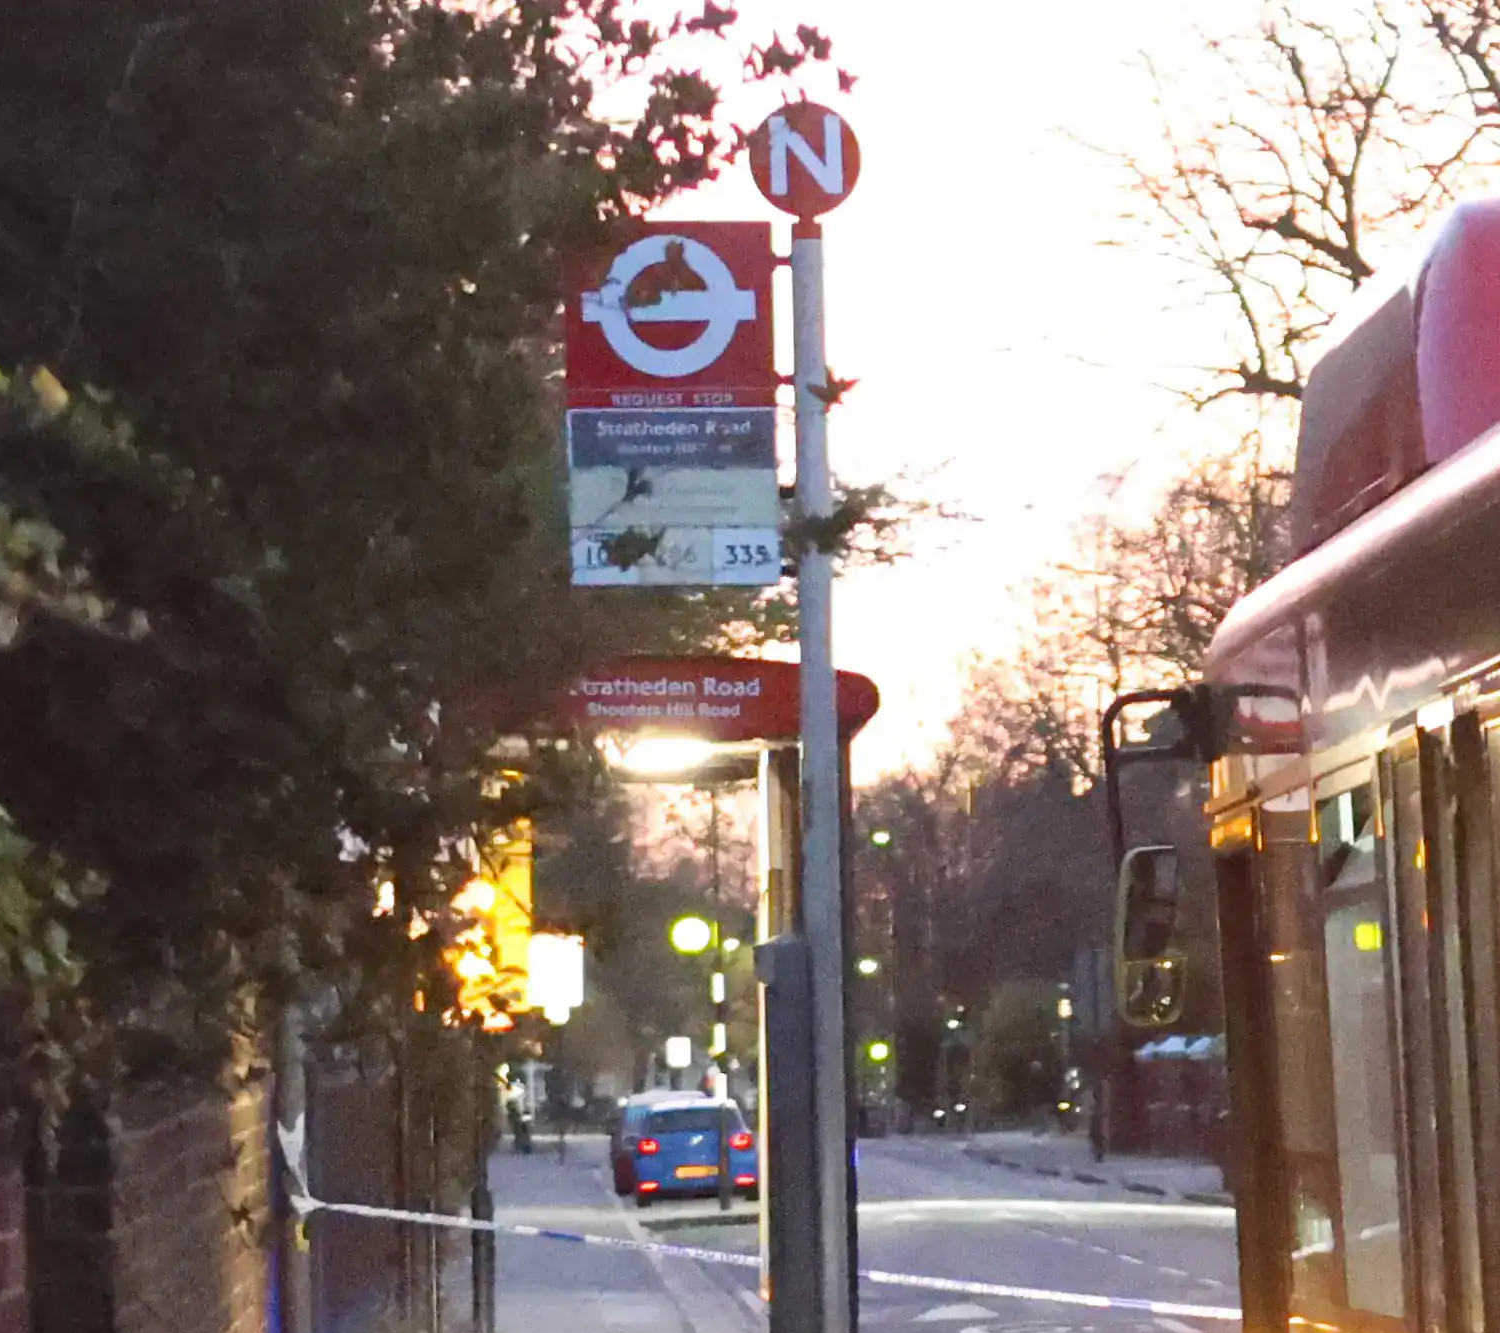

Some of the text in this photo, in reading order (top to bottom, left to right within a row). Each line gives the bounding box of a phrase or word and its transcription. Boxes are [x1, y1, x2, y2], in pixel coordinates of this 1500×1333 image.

[768, 114, 844, 196] N
[610, 393, 734, 406] REQUEST STOP
[597, 420, 699, 437] Stratheden
[704, 677, 761, 697] Road
[587, 703, 660, 717] Shooters
[700, 703, 741, 717] Road
